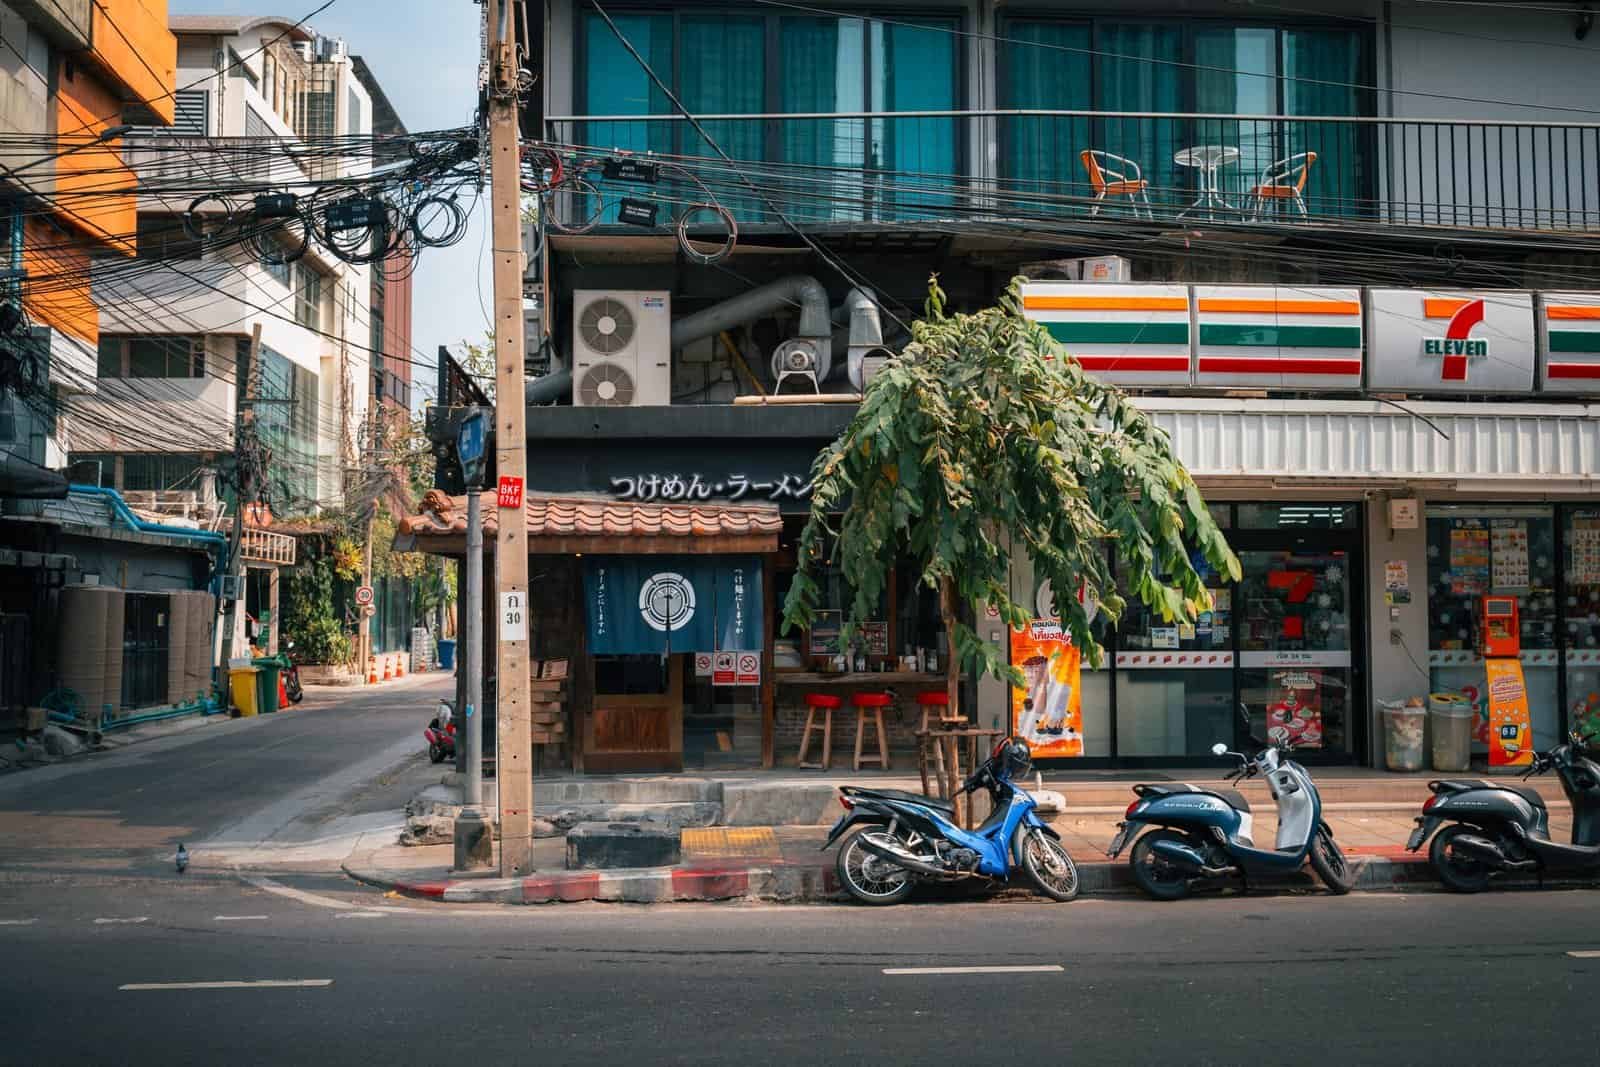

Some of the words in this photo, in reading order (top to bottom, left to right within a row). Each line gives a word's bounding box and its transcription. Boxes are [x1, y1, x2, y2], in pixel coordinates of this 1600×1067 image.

[1424, 298, 1484, 380] 7
[500, 485, 520, 495] BKF
[611, 474, 812, 500] つけめん・ラーメン
[506, 612, 520, 624] 30
